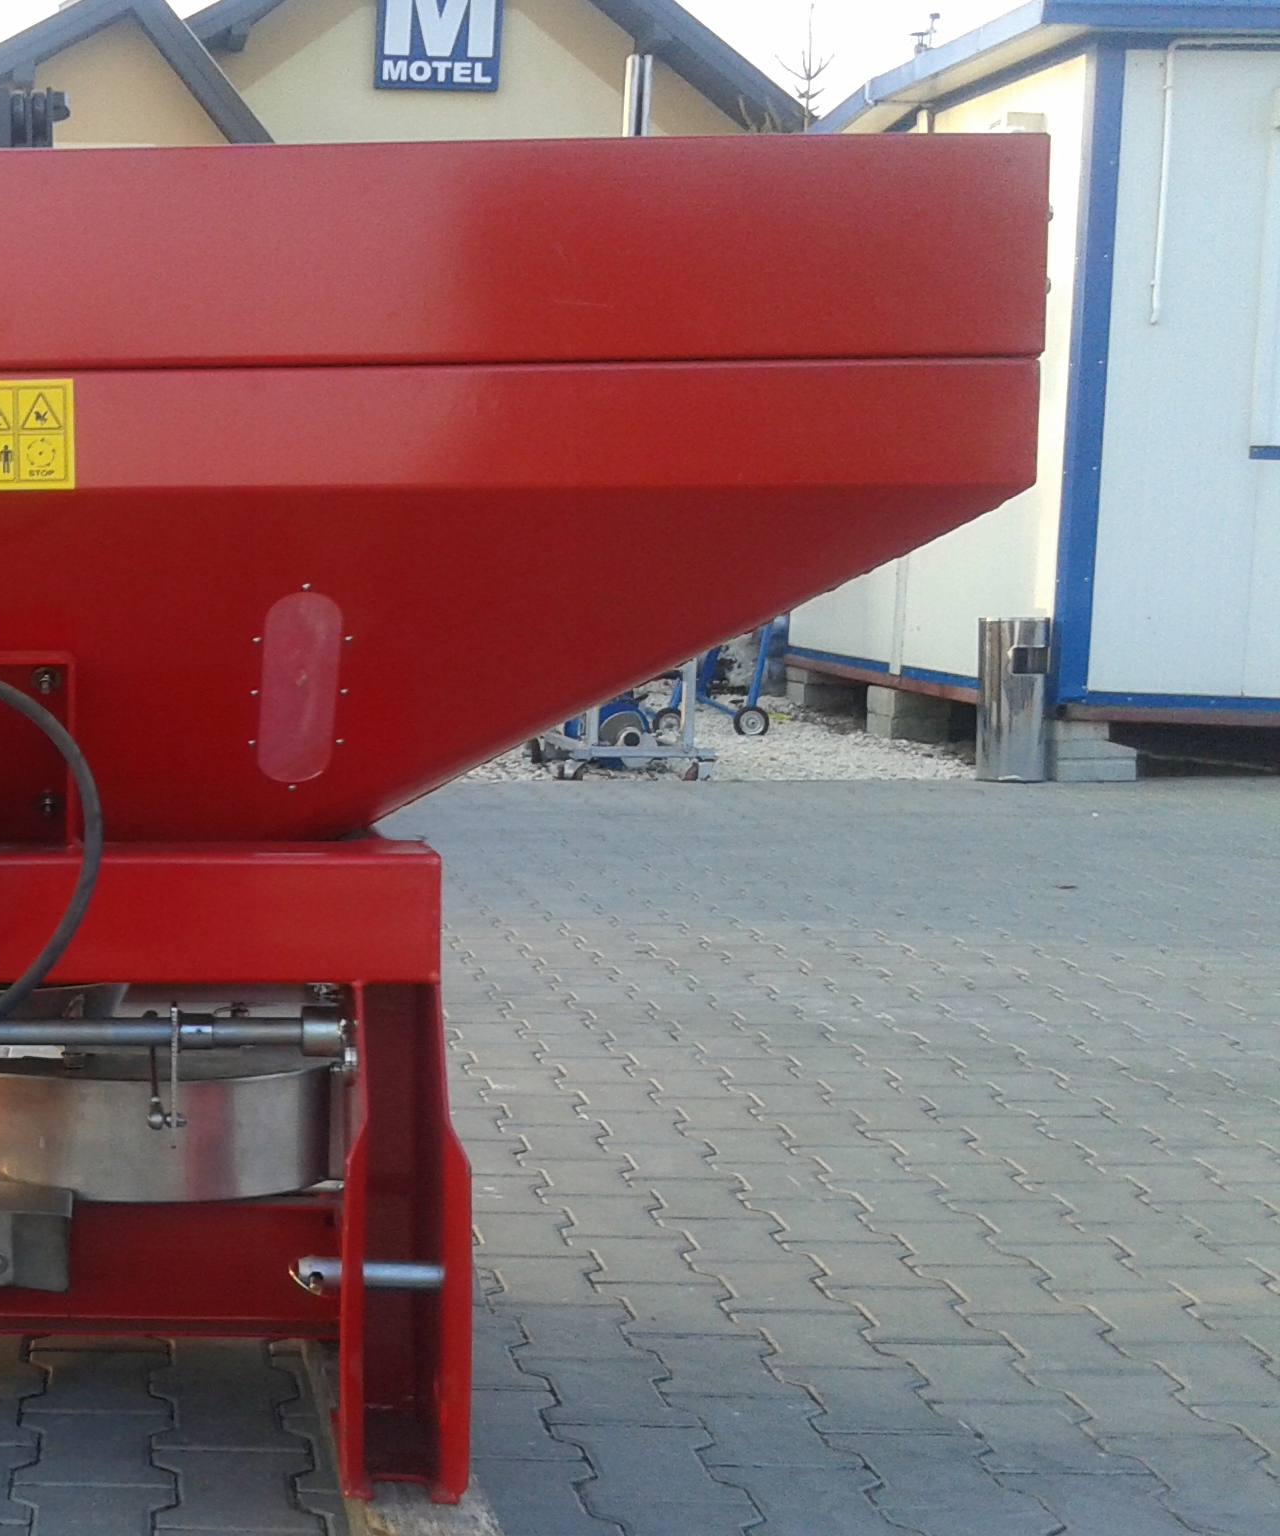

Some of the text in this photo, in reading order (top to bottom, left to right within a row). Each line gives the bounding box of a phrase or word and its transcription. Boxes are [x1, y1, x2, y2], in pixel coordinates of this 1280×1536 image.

[383, 0, 495, 58] M
[382, 60, 492, 83] MOTEL
[28, 469, 55, 477] STOP
